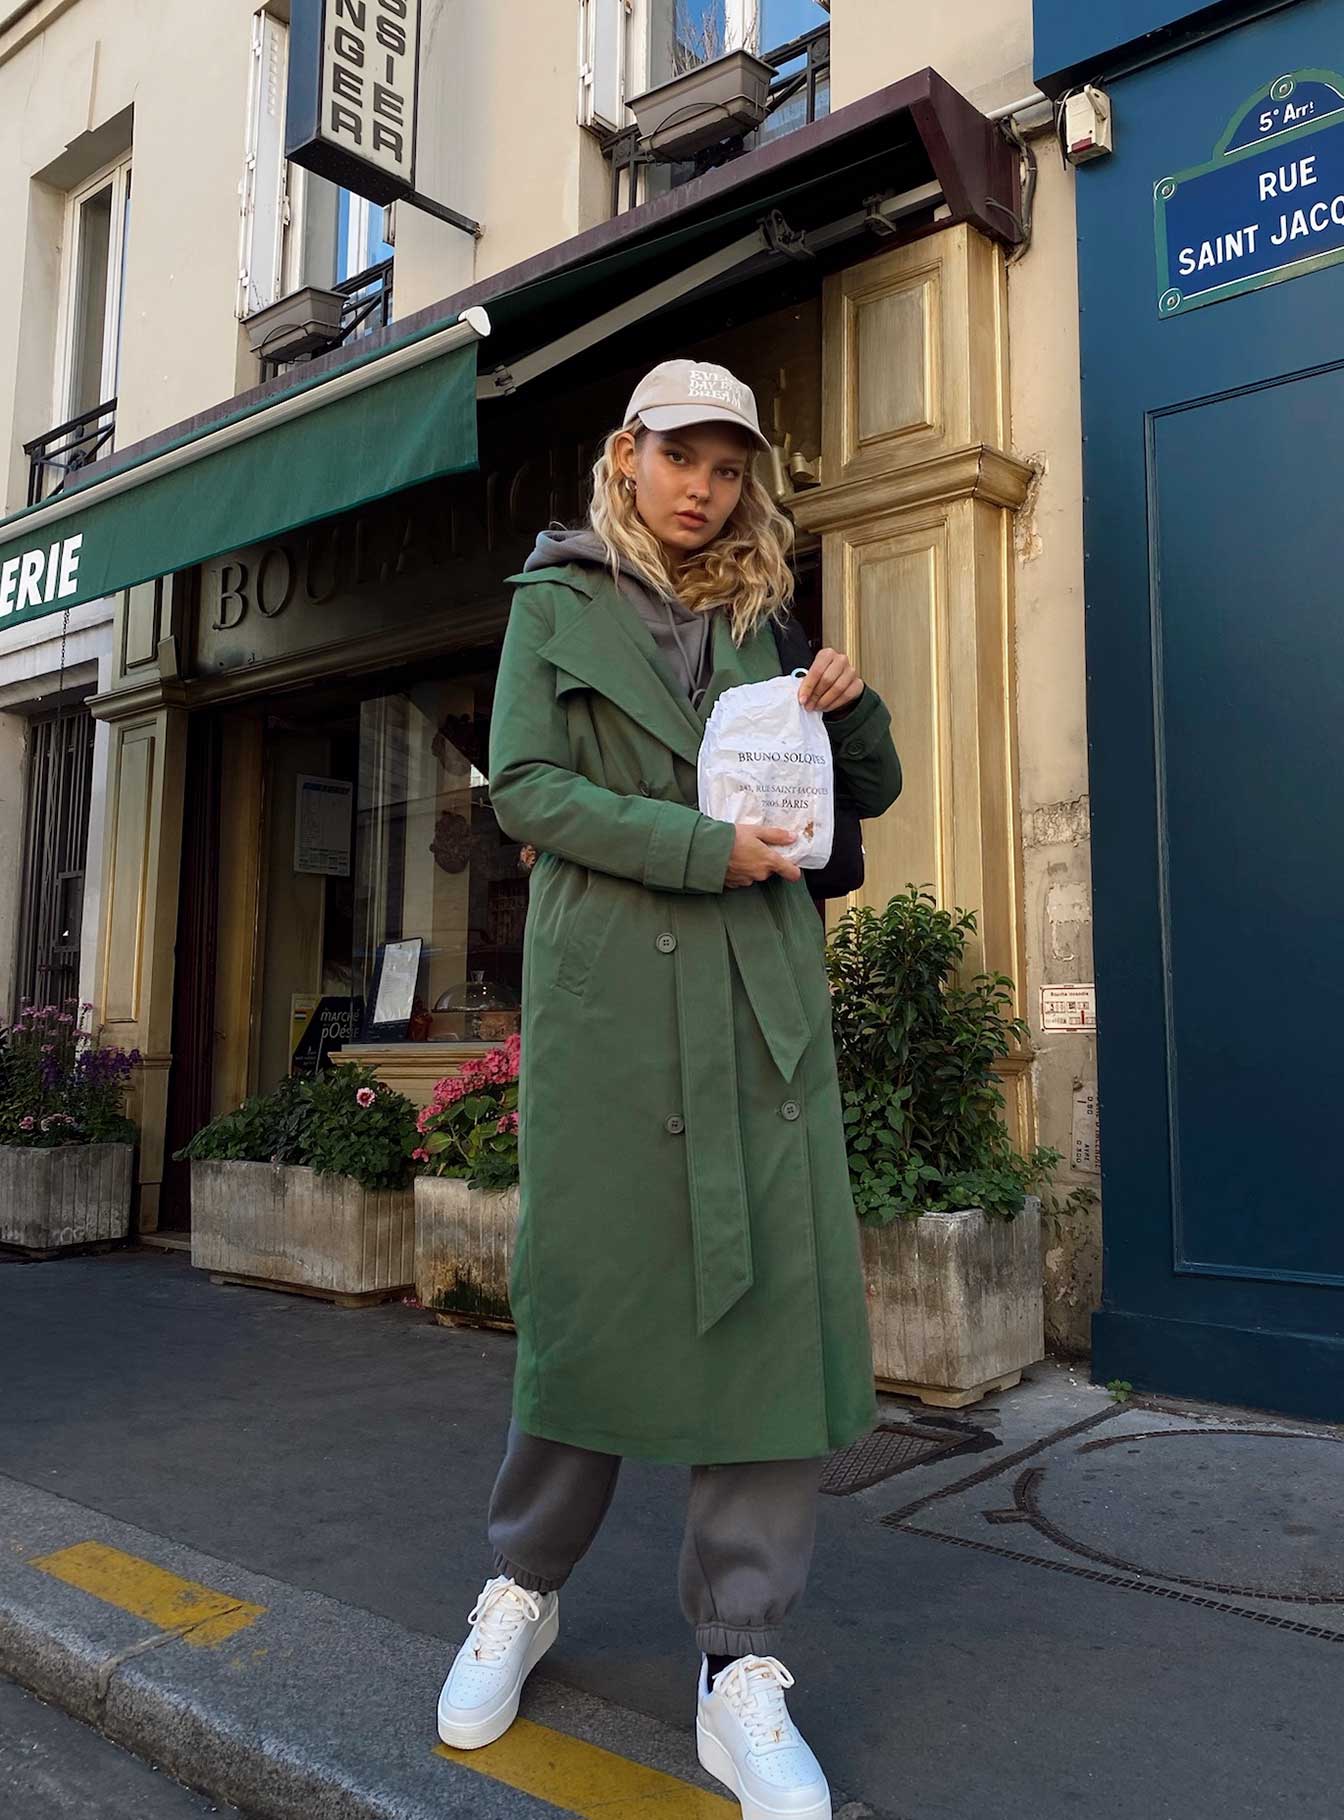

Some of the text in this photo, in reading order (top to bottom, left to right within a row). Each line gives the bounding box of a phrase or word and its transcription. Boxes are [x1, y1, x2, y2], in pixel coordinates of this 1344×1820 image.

[1258, 156, 1318, 201] RUE
[1178, 225, 1259, 276] SAINT
[688, 380, 717, 390] DAY
[0, 534, 83, 619] ERIE
[738, 751, 781, 762] BRUNO
[781, 799, 809, 809] PARIS
